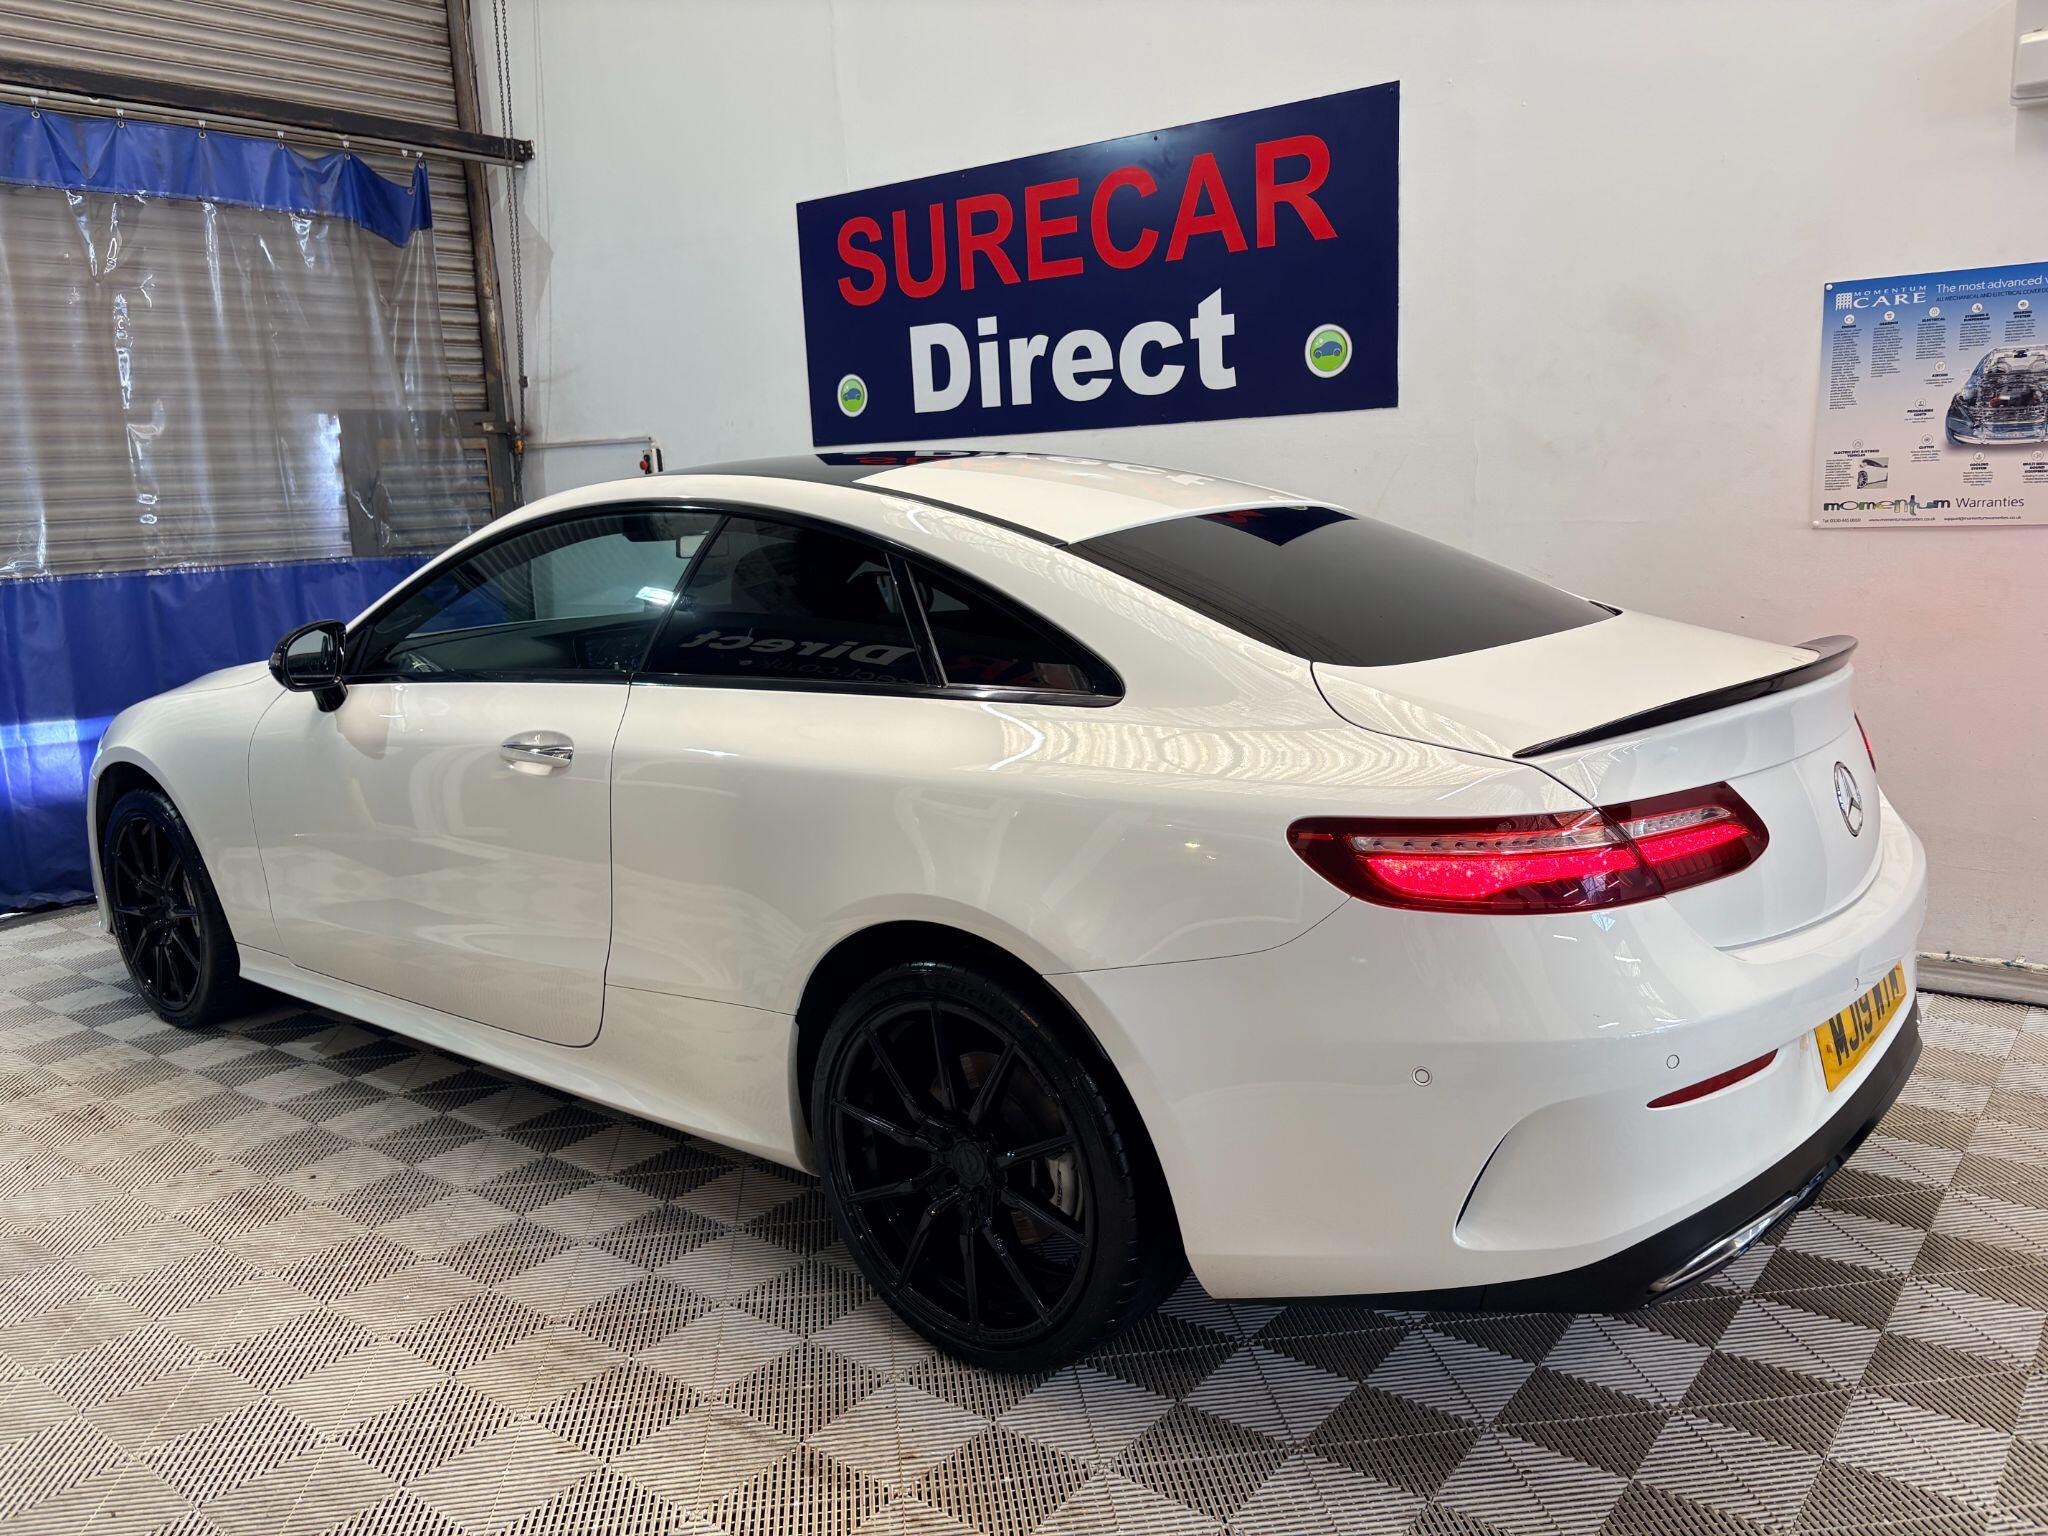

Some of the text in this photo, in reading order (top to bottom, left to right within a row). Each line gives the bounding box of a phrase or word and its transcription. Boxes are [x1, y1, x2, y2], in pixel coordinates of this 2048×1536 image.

[837, 135, 1338, 306] SURECAR
[1853, 285, 1927, 297] MOMENTUM
[1936, 283, 1957, 294] The
[1958, 280, 1986, 292] most
[1987, 275, 2043, 290] advanced
[1853, 292, 1927, 309] CARE
[909, 288, 1237, 413] Direct
[1823, 495, 2025, 516] momentum Warranties
[1829, 992, 1873, 1066] MJ19
